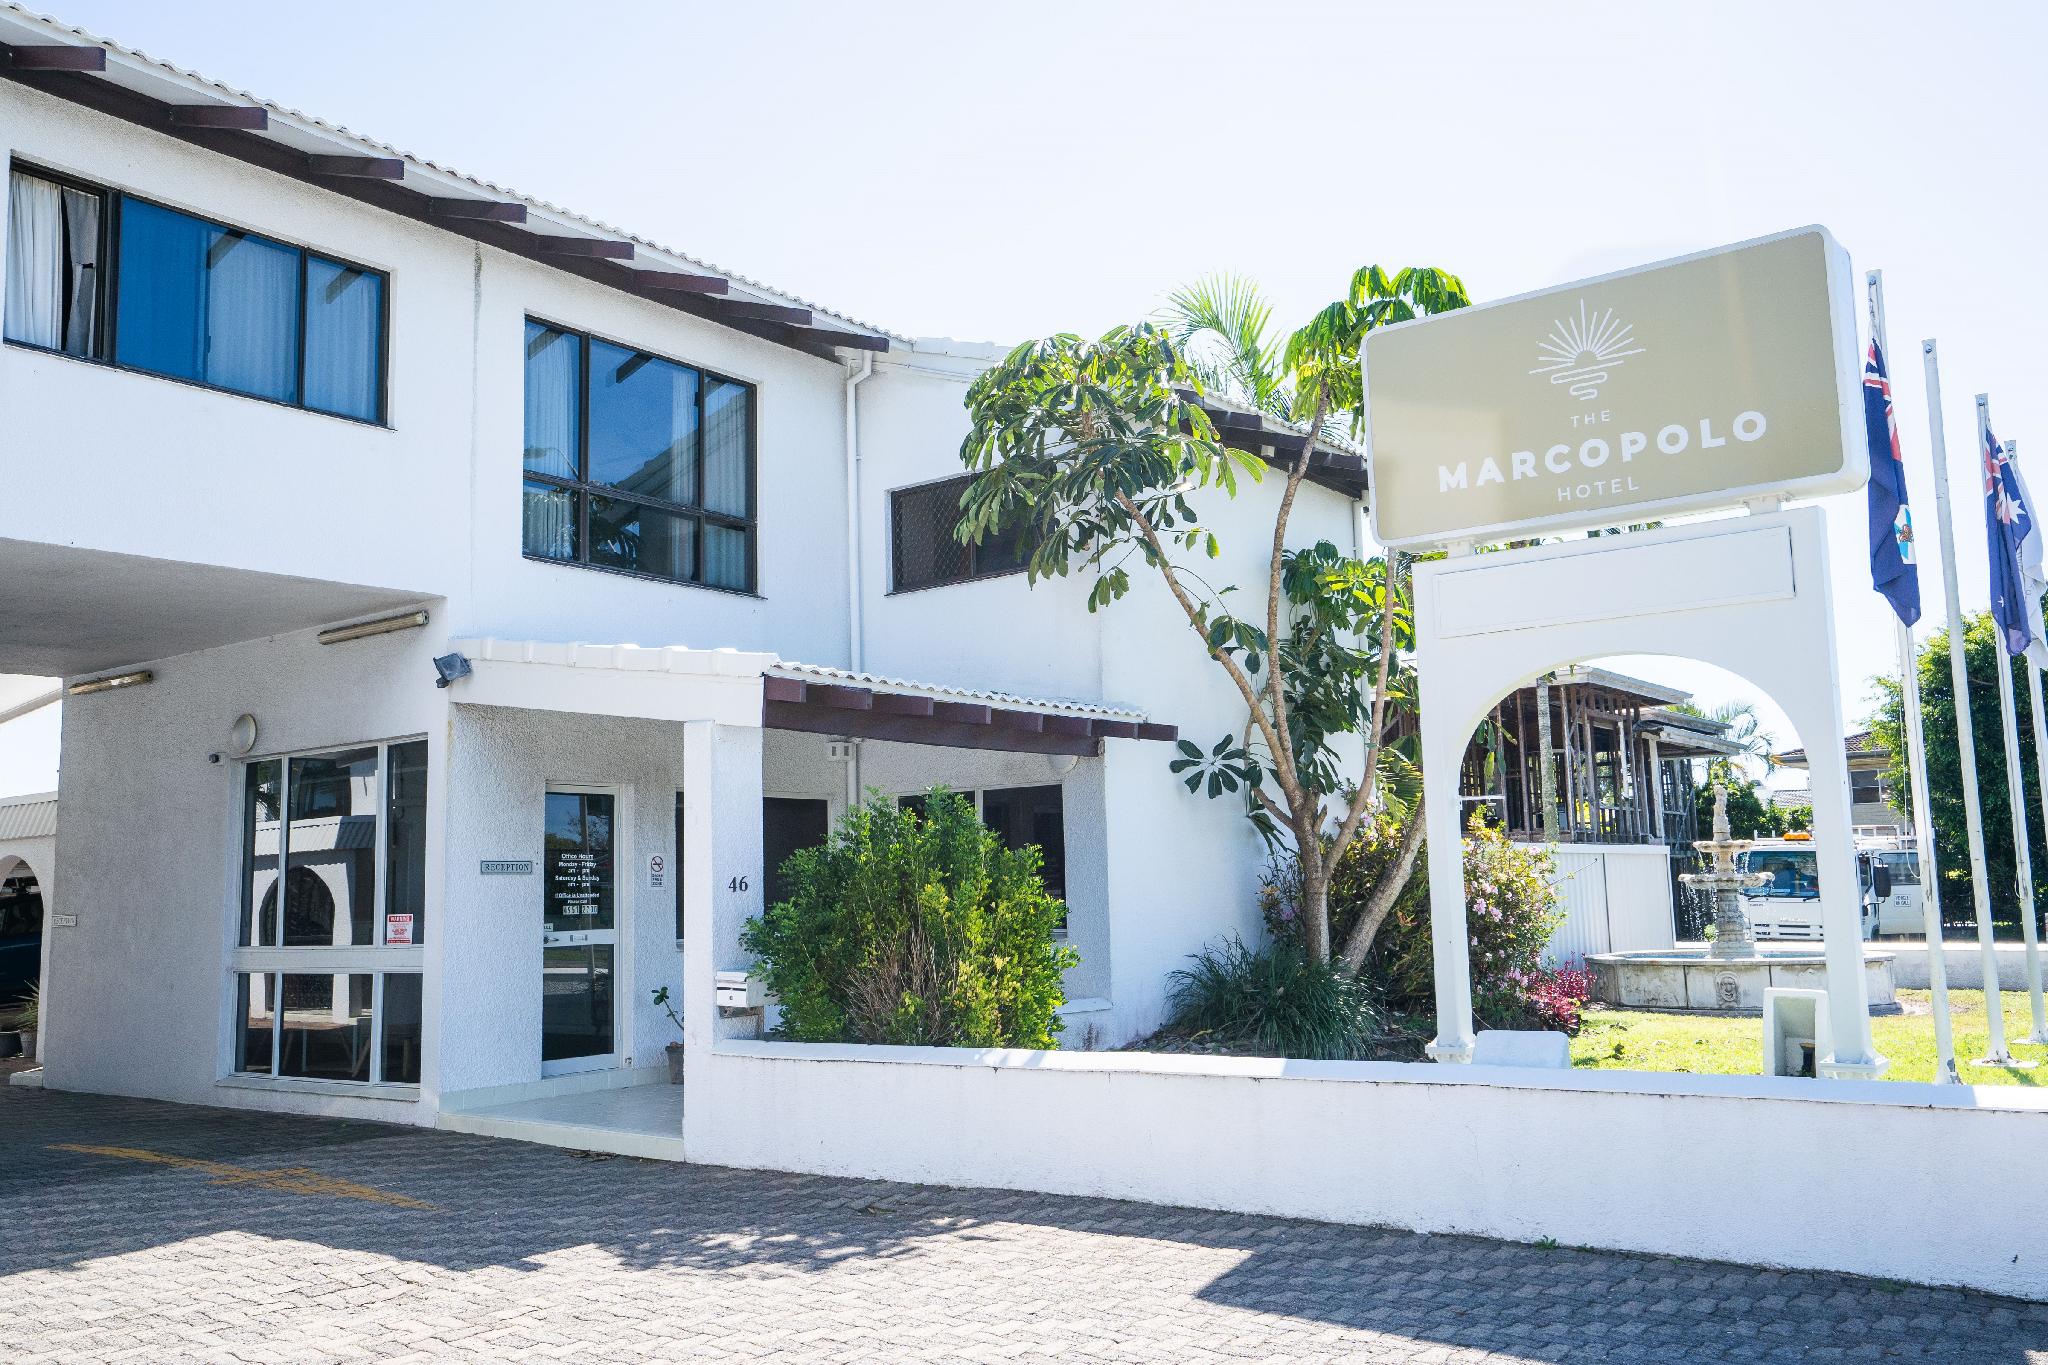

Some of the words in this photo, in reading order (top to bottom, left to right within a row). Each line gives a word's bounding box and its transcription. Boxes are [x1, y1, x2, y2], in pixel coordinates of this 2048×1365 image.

[1570, 409, 1611, 428] THE
[1558, 476, 1640, 502] HOTEL
[484, 863, 530, 871] RECEPTION
[728, 875, 749, 893] 46
